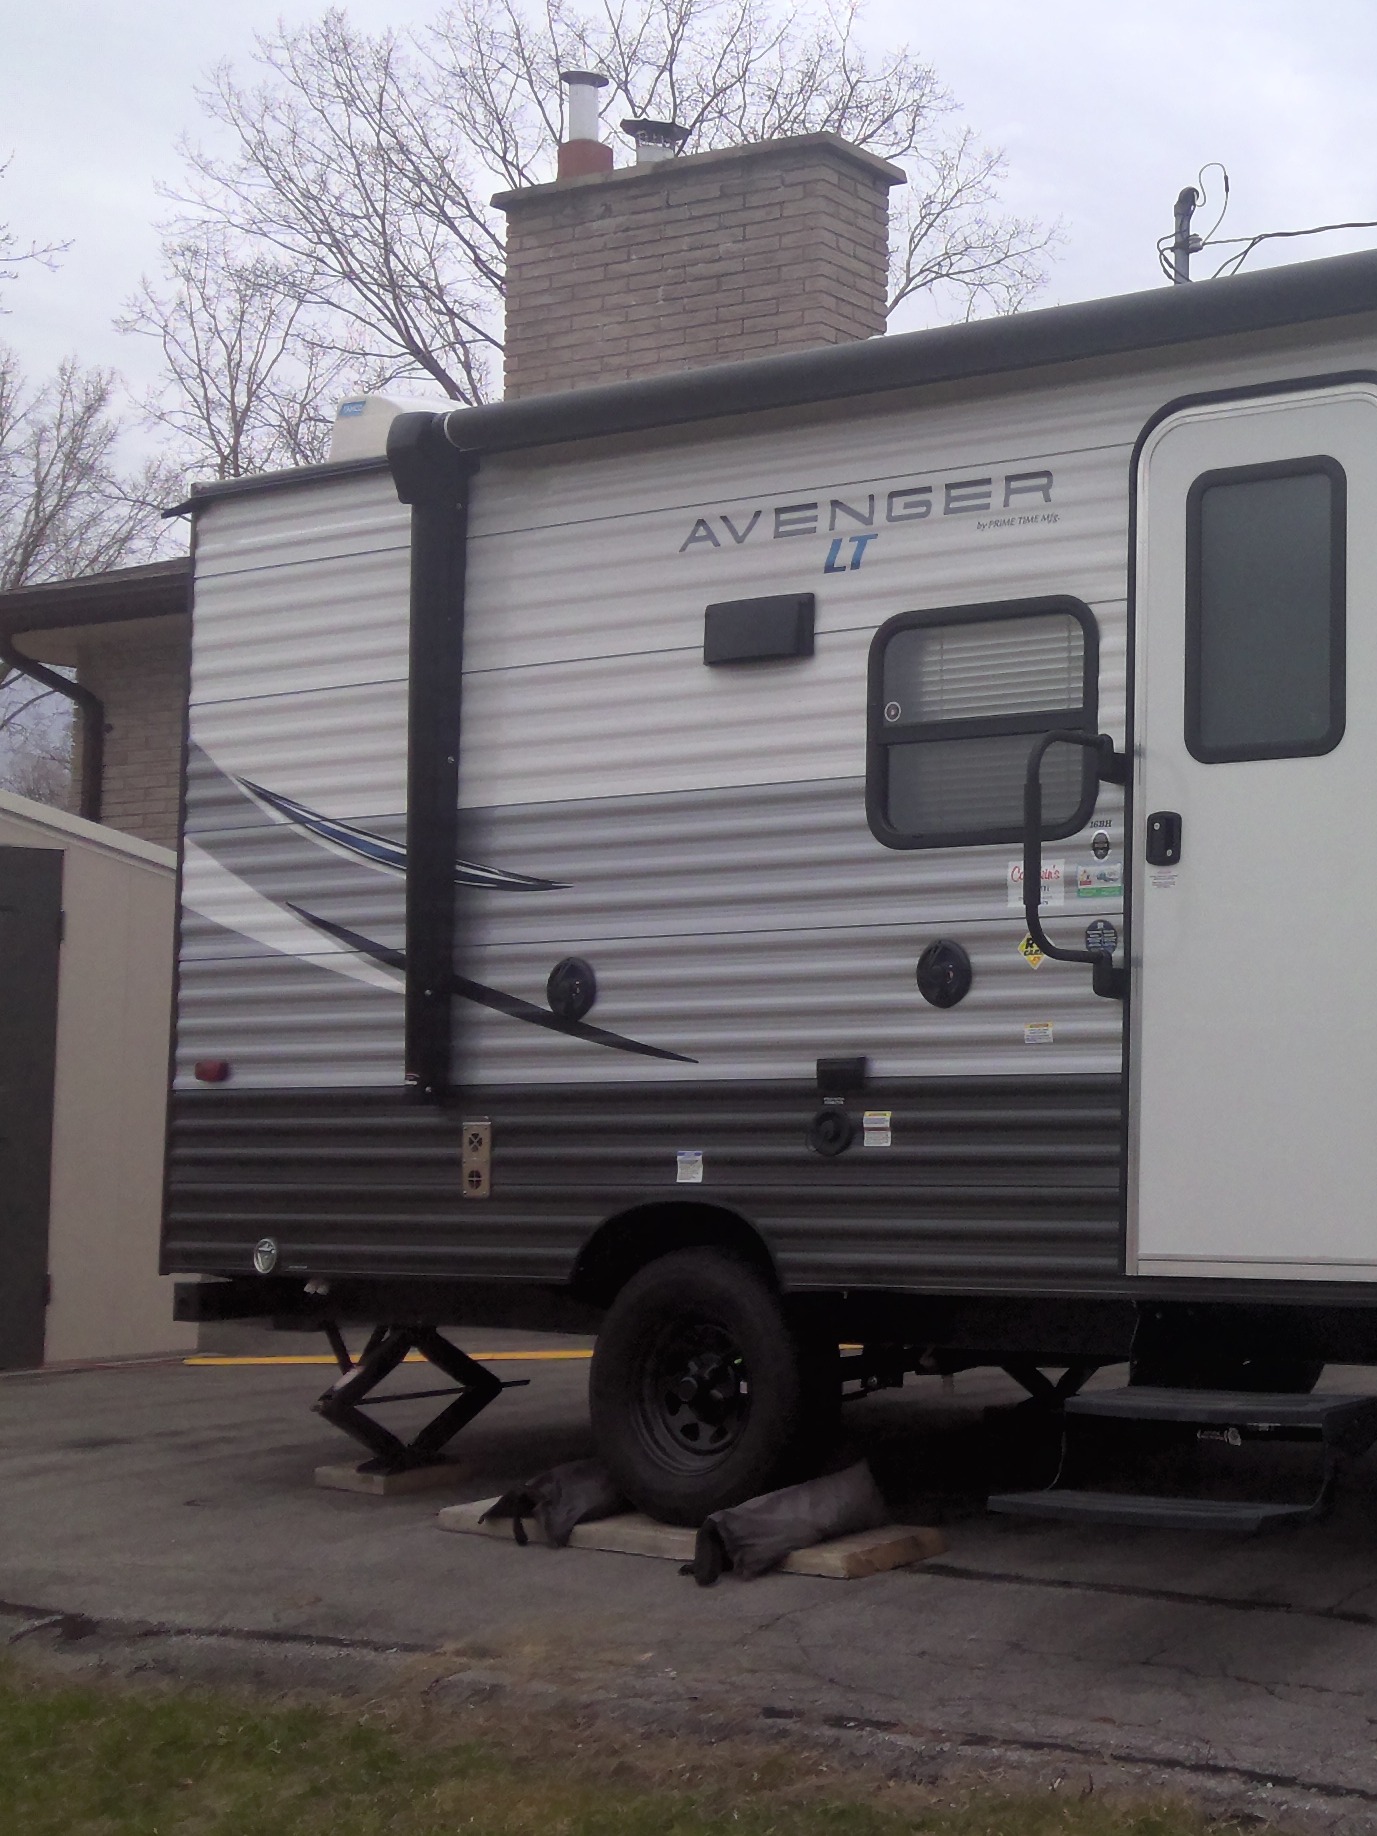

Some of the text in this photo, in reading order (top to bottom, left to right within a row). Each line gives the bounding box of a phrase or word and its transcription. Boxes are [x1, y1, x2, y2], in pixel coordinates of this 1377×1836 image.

[679, 470, 1054, 553] AVENGER
[988, 517, 1016, 529] PRIME
[1017, 514, 1040, 525] TIME
[824, 533, 878, 574] LT
[1089, 819, 1112, 829] 16BH
